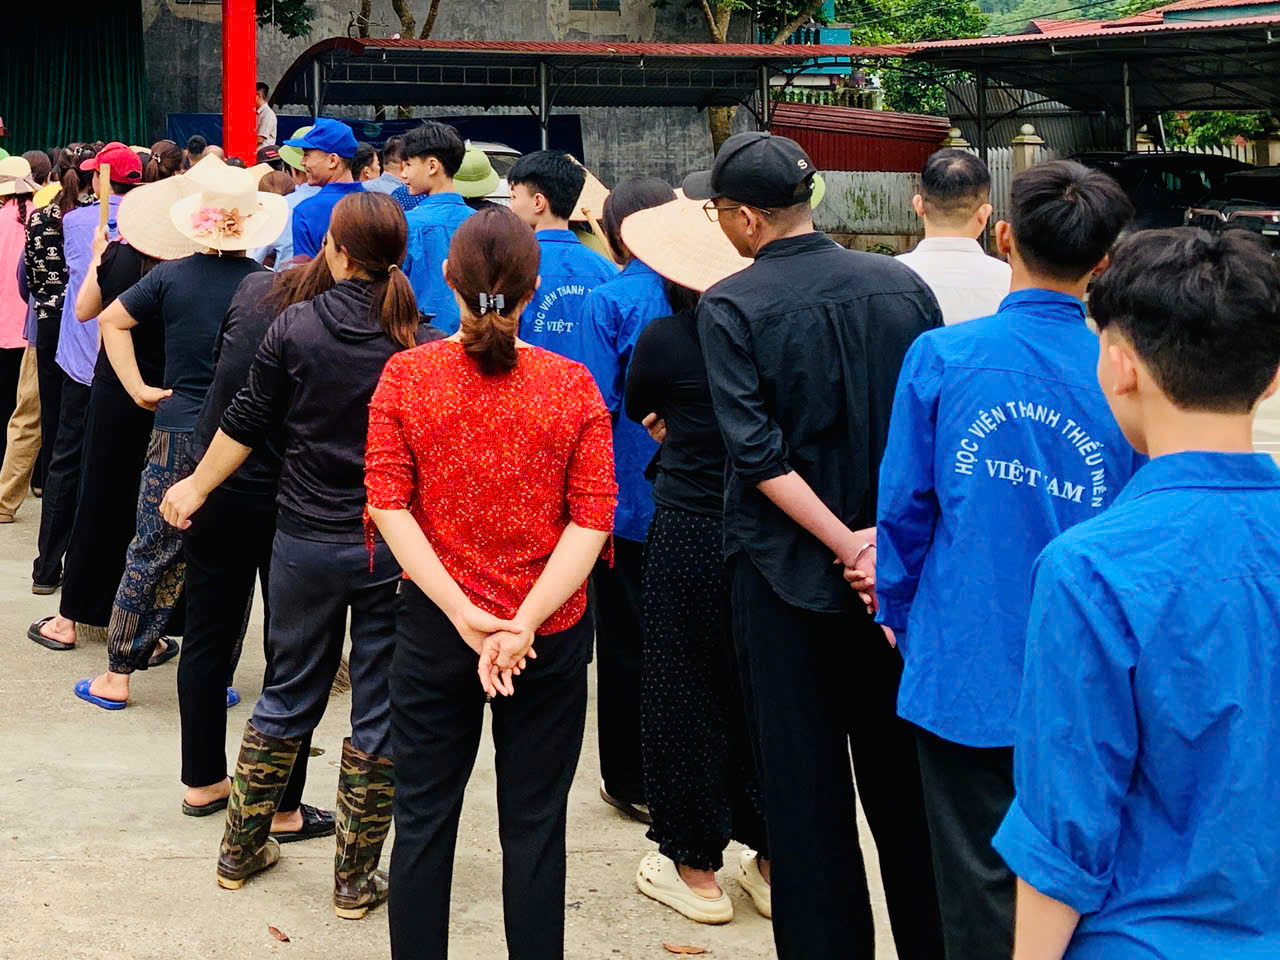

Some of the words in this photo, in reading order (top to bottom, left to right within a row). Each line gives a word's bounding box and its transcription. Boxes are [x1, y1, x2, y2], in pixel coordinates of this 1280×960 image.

[533, 311, 546, 333] HỌC
[540, 291, 558, 311] VIỆN
[556, 284, 585, 297] THANH
[546, 318, 574, 334] VIỆT
[954, 438, 979, 476] HỌC
[967, 406, 1007, 439] VIỆN
[1061, 418, 1105, 467] THIẾU
[1090, 467, 1108, 508] NIÊN
[985, 458, 1043, 488] VIỆT
[1043, 473, 1086, 504] AM
